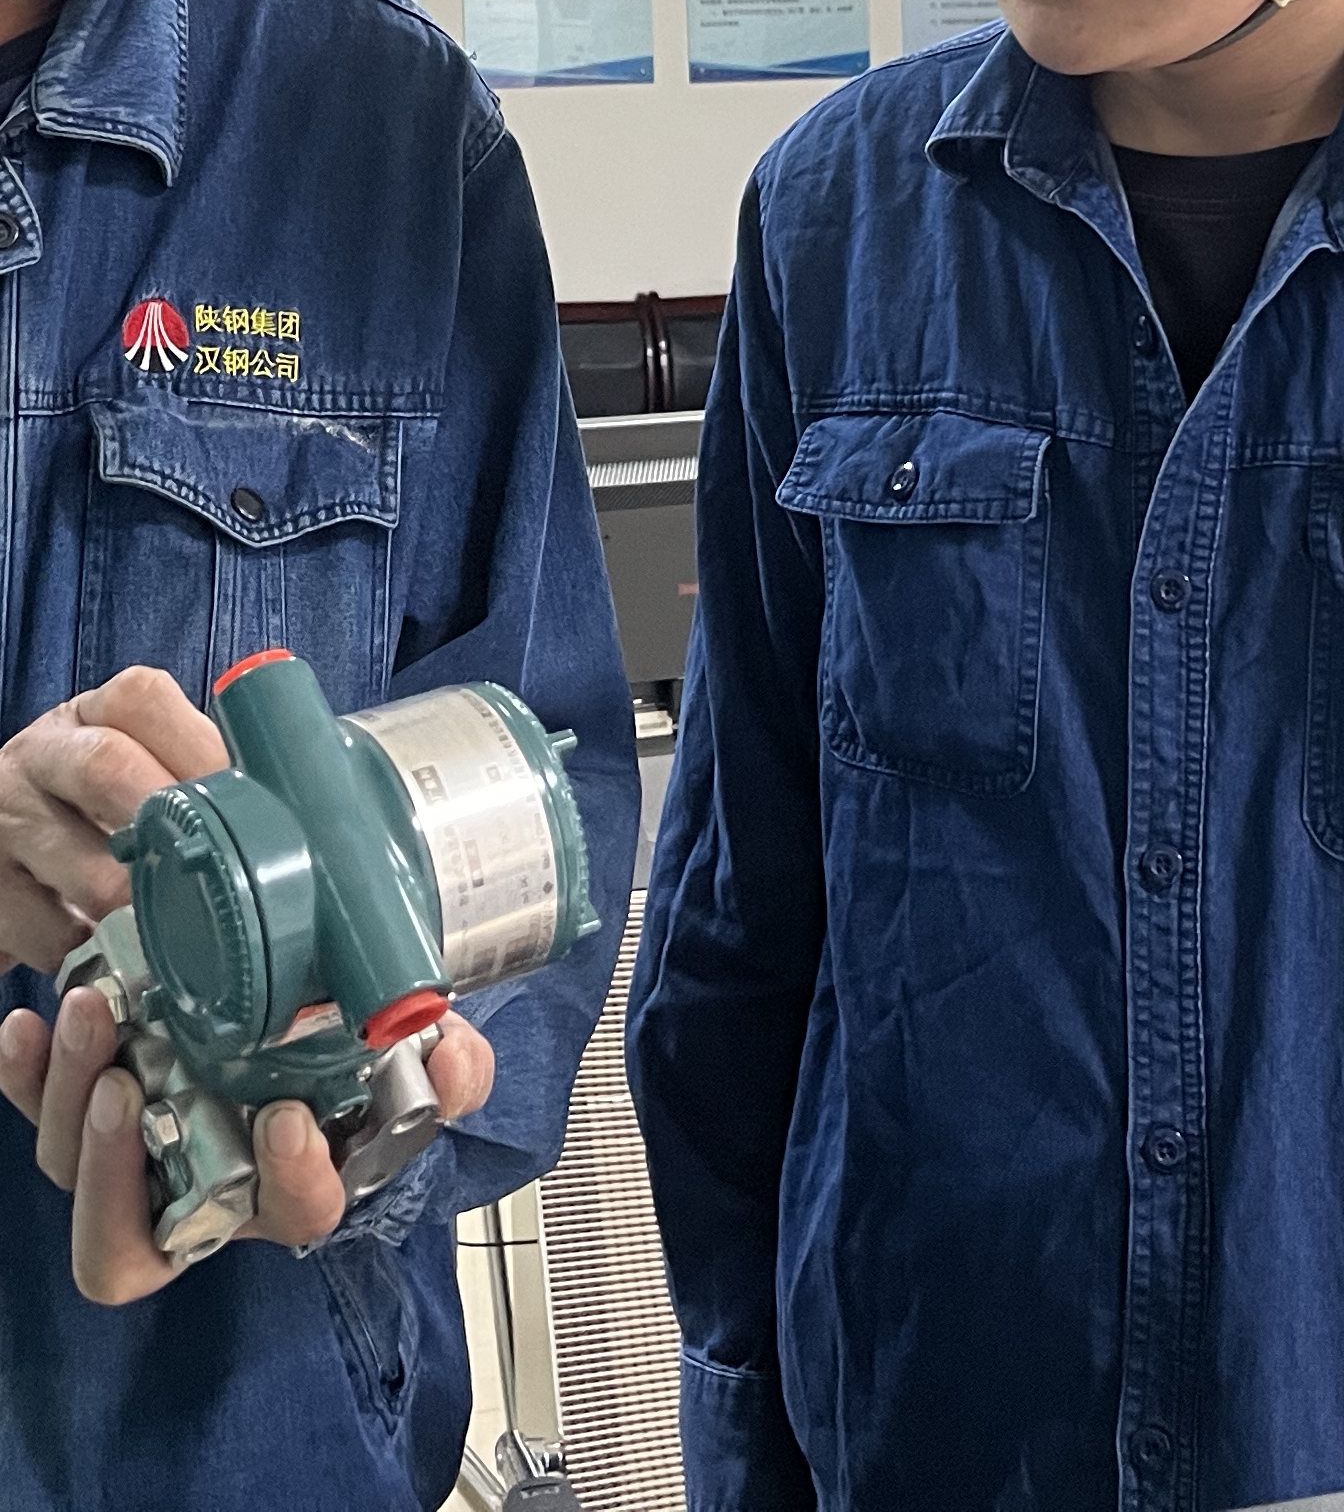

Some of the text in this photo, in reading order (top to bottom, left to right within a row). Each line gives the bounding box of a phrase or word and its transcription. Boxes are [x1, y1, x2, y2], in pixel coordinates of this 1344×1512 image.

[193, 304, 301, 342] 陕钢集团
[193, 345, 300, 383] 汉钢公司
